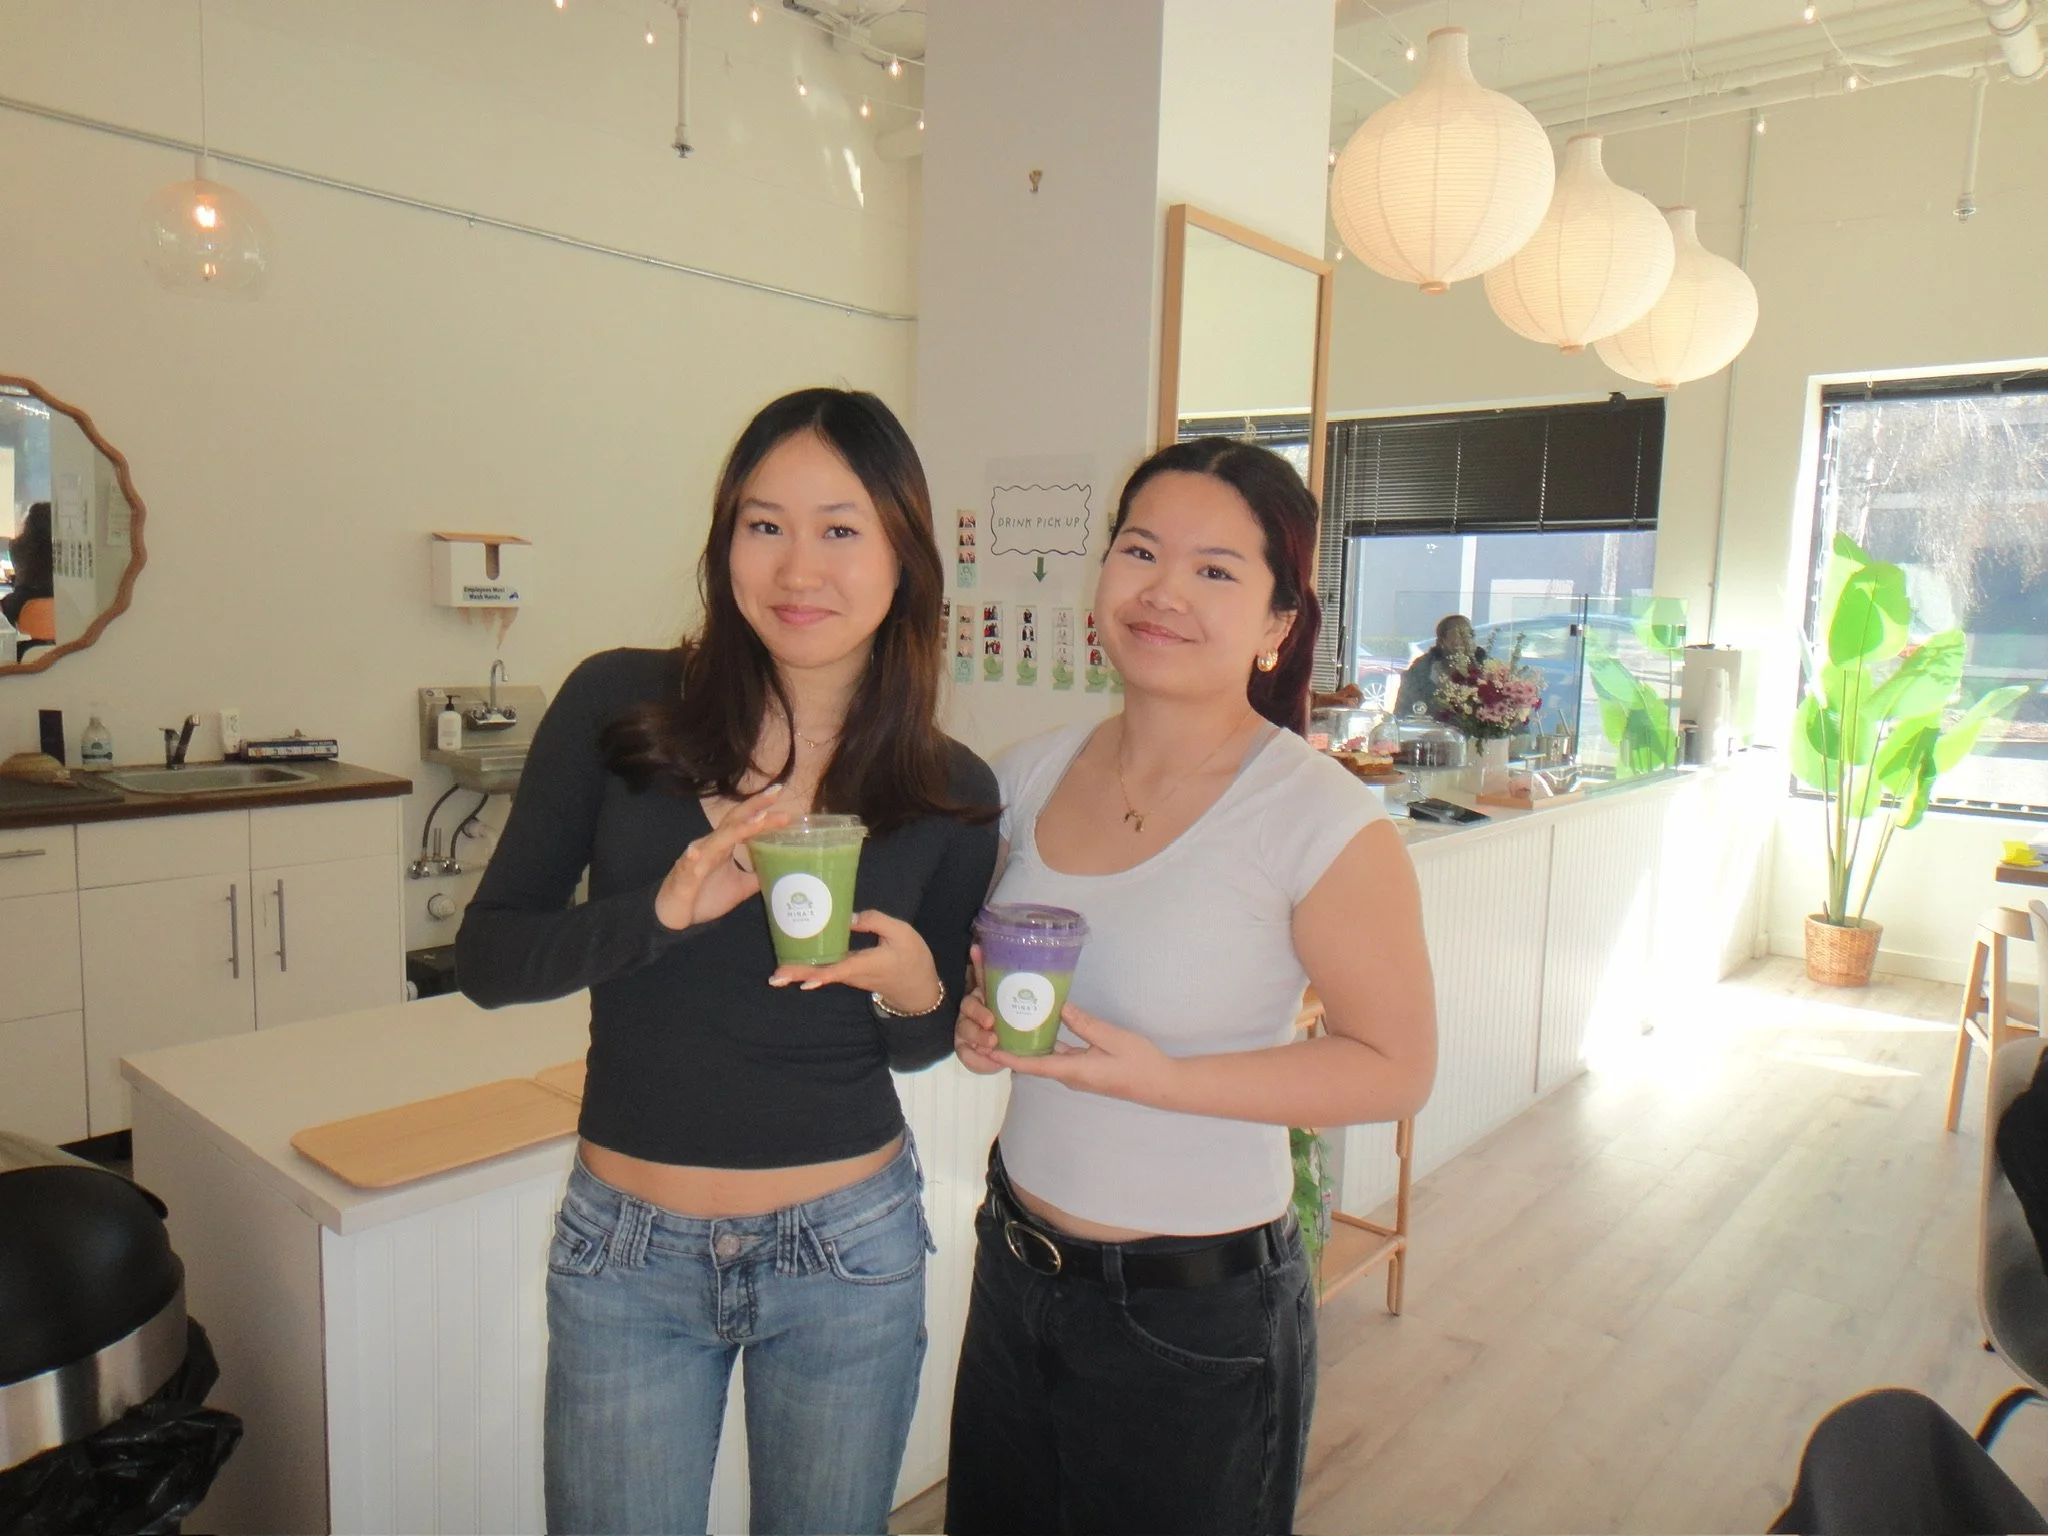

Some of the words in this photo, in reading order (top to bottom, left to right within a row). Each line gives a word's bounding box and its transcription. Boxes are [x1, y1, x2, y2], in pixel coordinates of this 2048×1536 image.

[998, 517, 1032, 528] DRINK
[1036, 516, 1061, 528] PICK
[1066, 516, 1080, 528] UP
